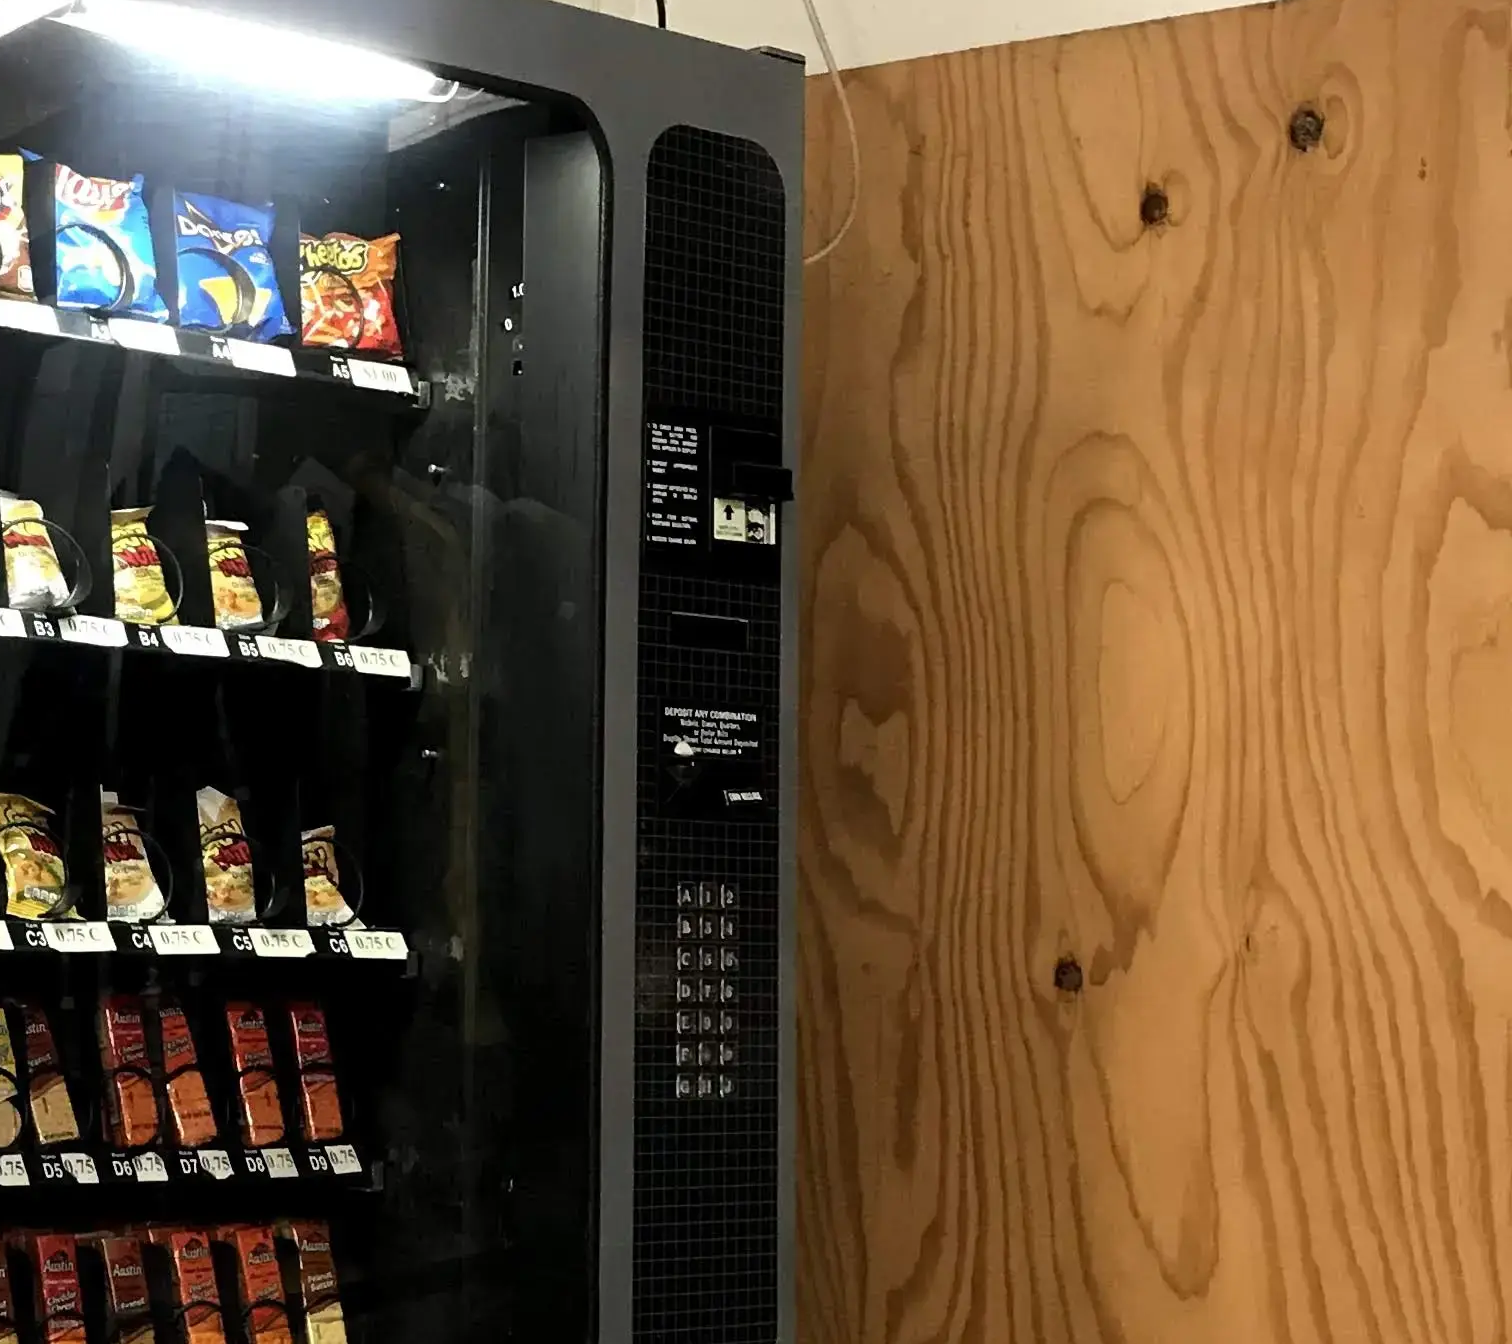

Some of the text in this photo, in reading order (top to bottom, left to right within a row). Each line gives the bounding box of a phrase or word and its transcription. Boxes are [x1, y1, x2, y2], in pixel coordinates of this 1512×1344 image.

[34, 621, 55, 637] B3
[138, 631, 159, 647] B4
[239, 642, 259, 657] B5
[335, 652, 353, 667] B6
[360, 652, 387, 666] 0.75
[665, 707, 756, 722] DEPOSIT ANY COMBINATION
[683, 890, 691, 902] A
[26, 930, 47, 946] C3
[55, 927, 85, 942] 0.75
[132, 933, 152, 948] C4
[160, 931, 190, 944] 0.75
[261, 934, 289, 948] 0.75
[233, 935, 252, 951] C5
[329, 938, 348, 953] C6
[355, 936, 383, 950] 0.75
[682, 952, 690, 966] C
[682, 984, 690, 998] D
[133, 1156, 163, 1172] 0.75
[202, 1156, 230, 1171] 0.75
[267, 1153, 294, 1167] 0.75
[309, 1155, 328, 1171] D9
[330, 1149, 358, 1164] 0.75
[43, 1162, 63, 1178] D5
[65, 1159, 95, 1174] 0.75
[112, 1160, 133, 1176] D6
[180, 1159, 197, 1174] D7
[246, 1157, 265, 1172] D8
[43, 1260, 74, 1272] Austin
[113, 1264, 142, 1277] Austin
